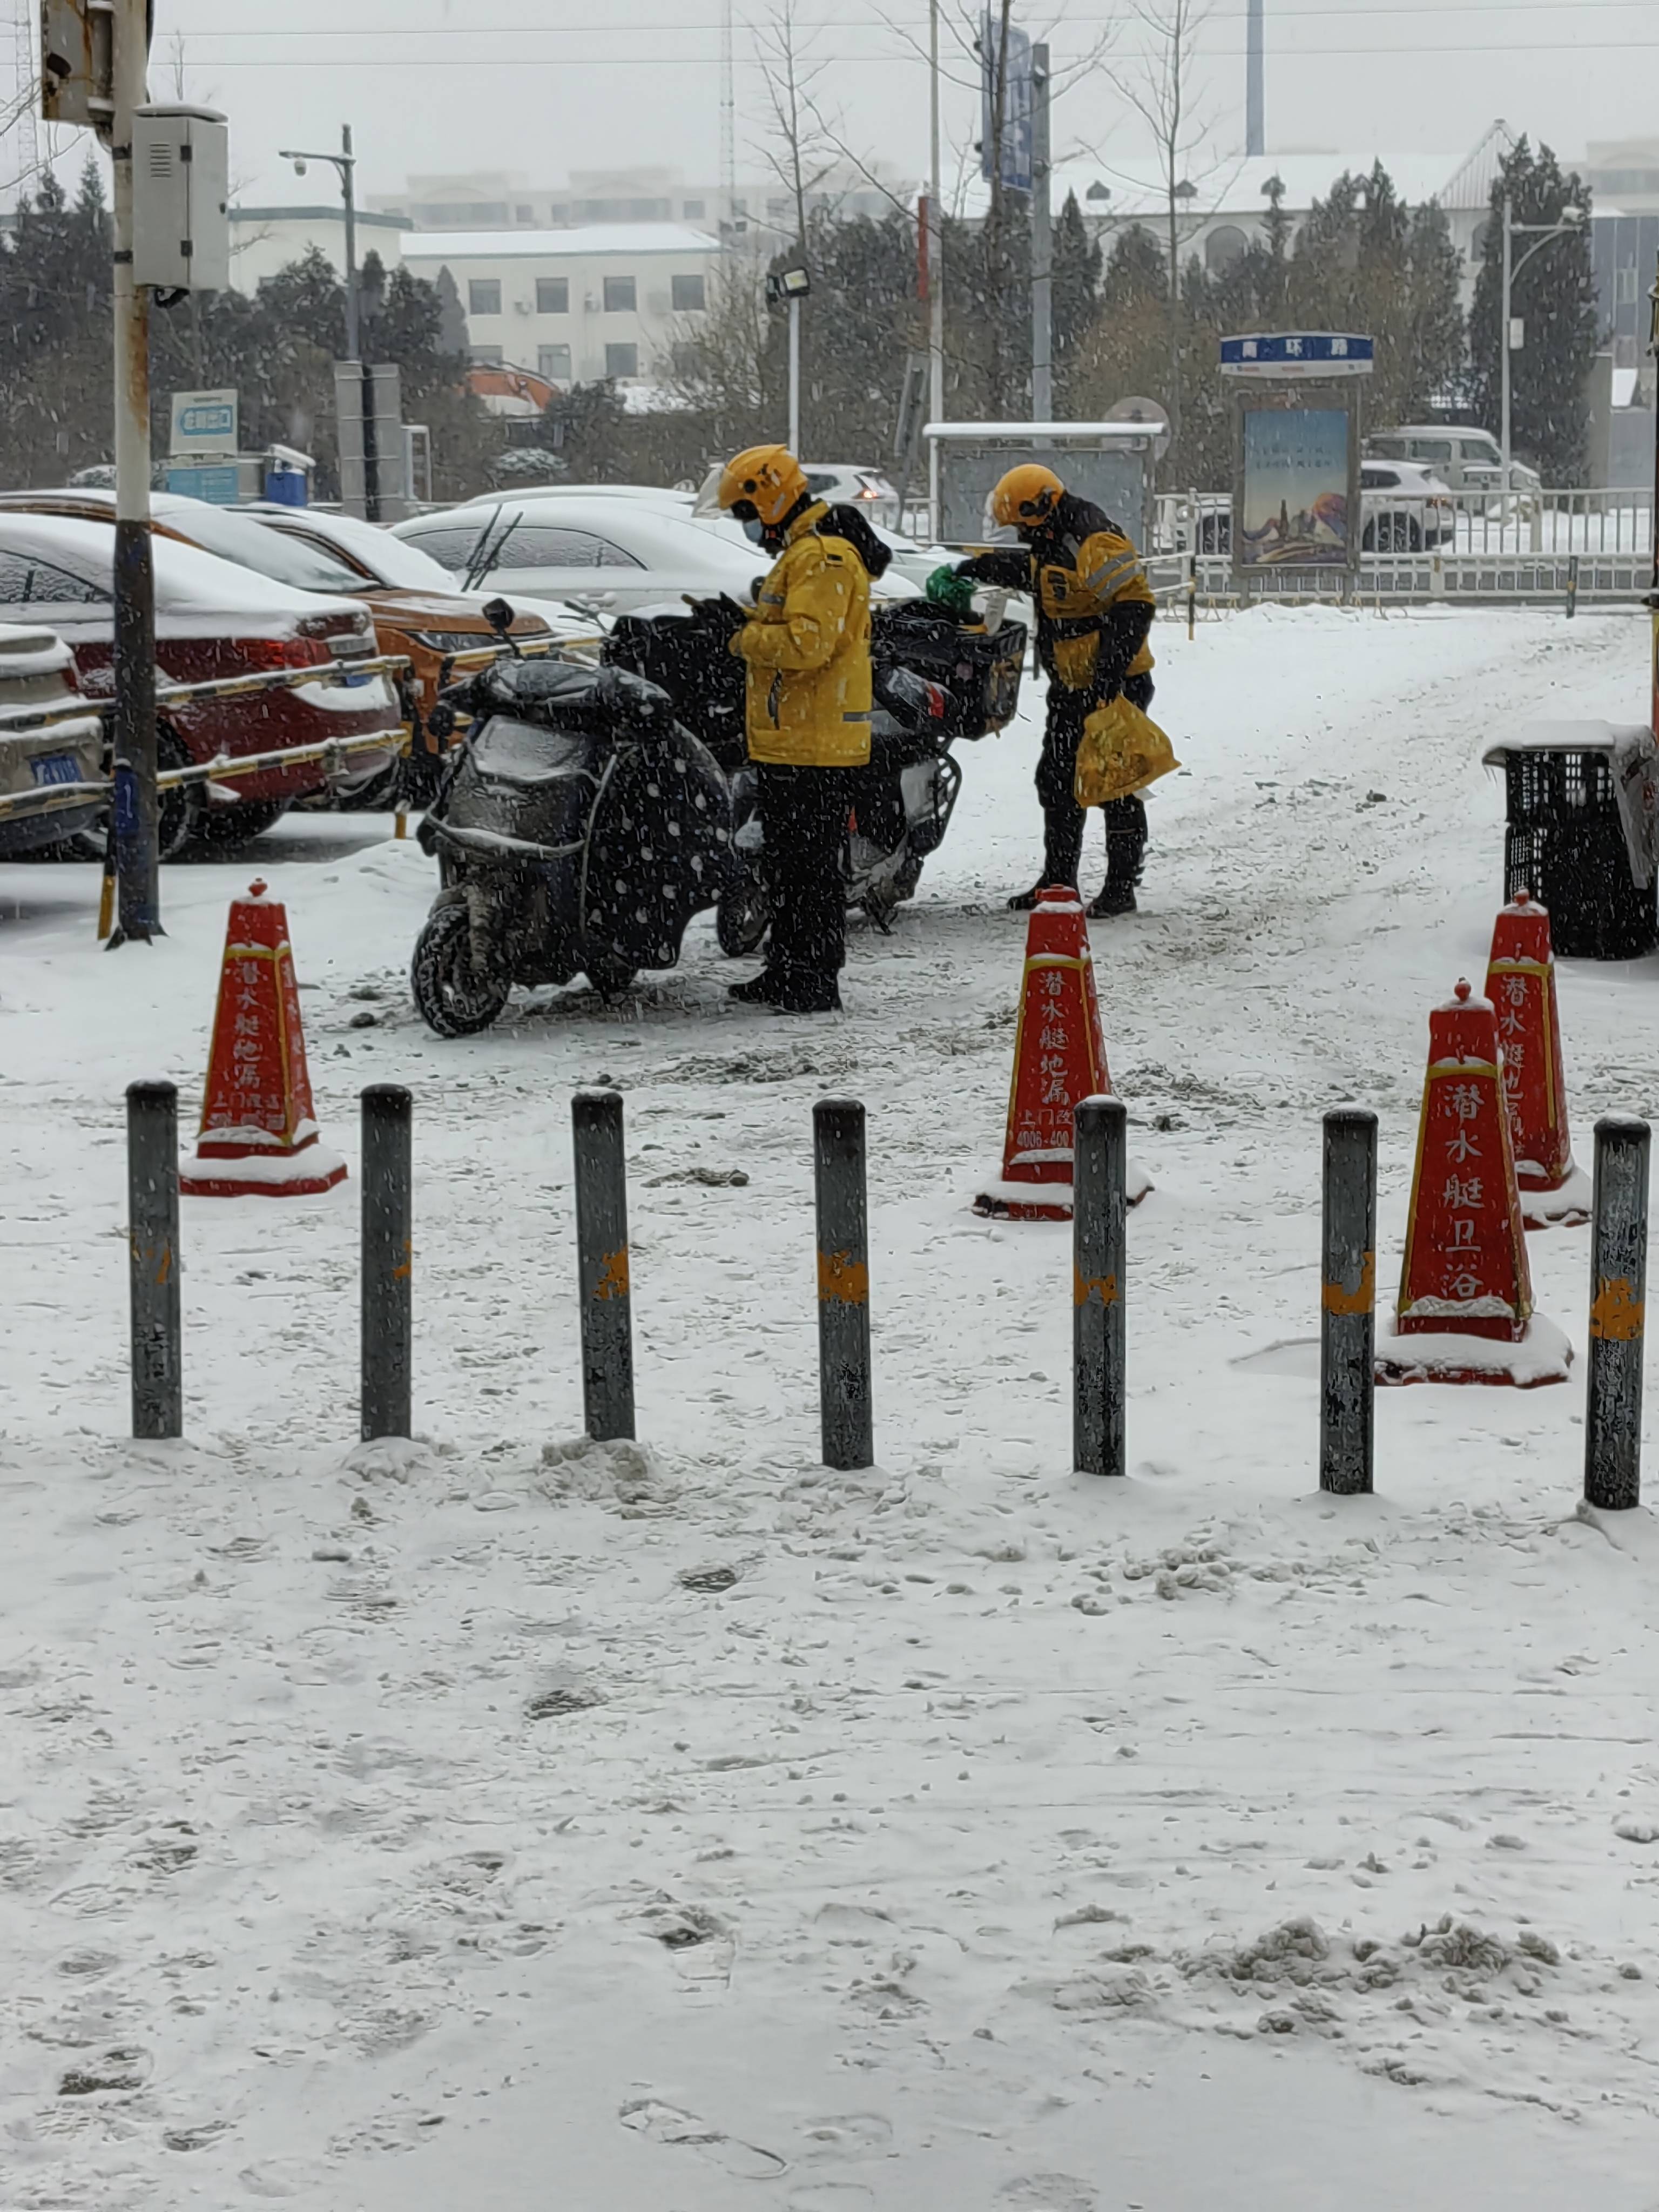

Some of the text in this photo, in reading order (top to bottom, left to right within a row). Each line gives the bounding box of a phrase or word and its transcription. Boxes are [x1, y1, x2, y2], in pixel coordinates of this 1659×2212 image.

[1243, 339, 1348, 358] 环路
[1039, 971, 1069, 1105] 潜水艇地漏
[1020, 1109, 1073, 1125] 上门改
[1017, 1131, 1074, 1148] 4006-400
[1442, 1083, 1485, 1297] 潜水艇卫浴
